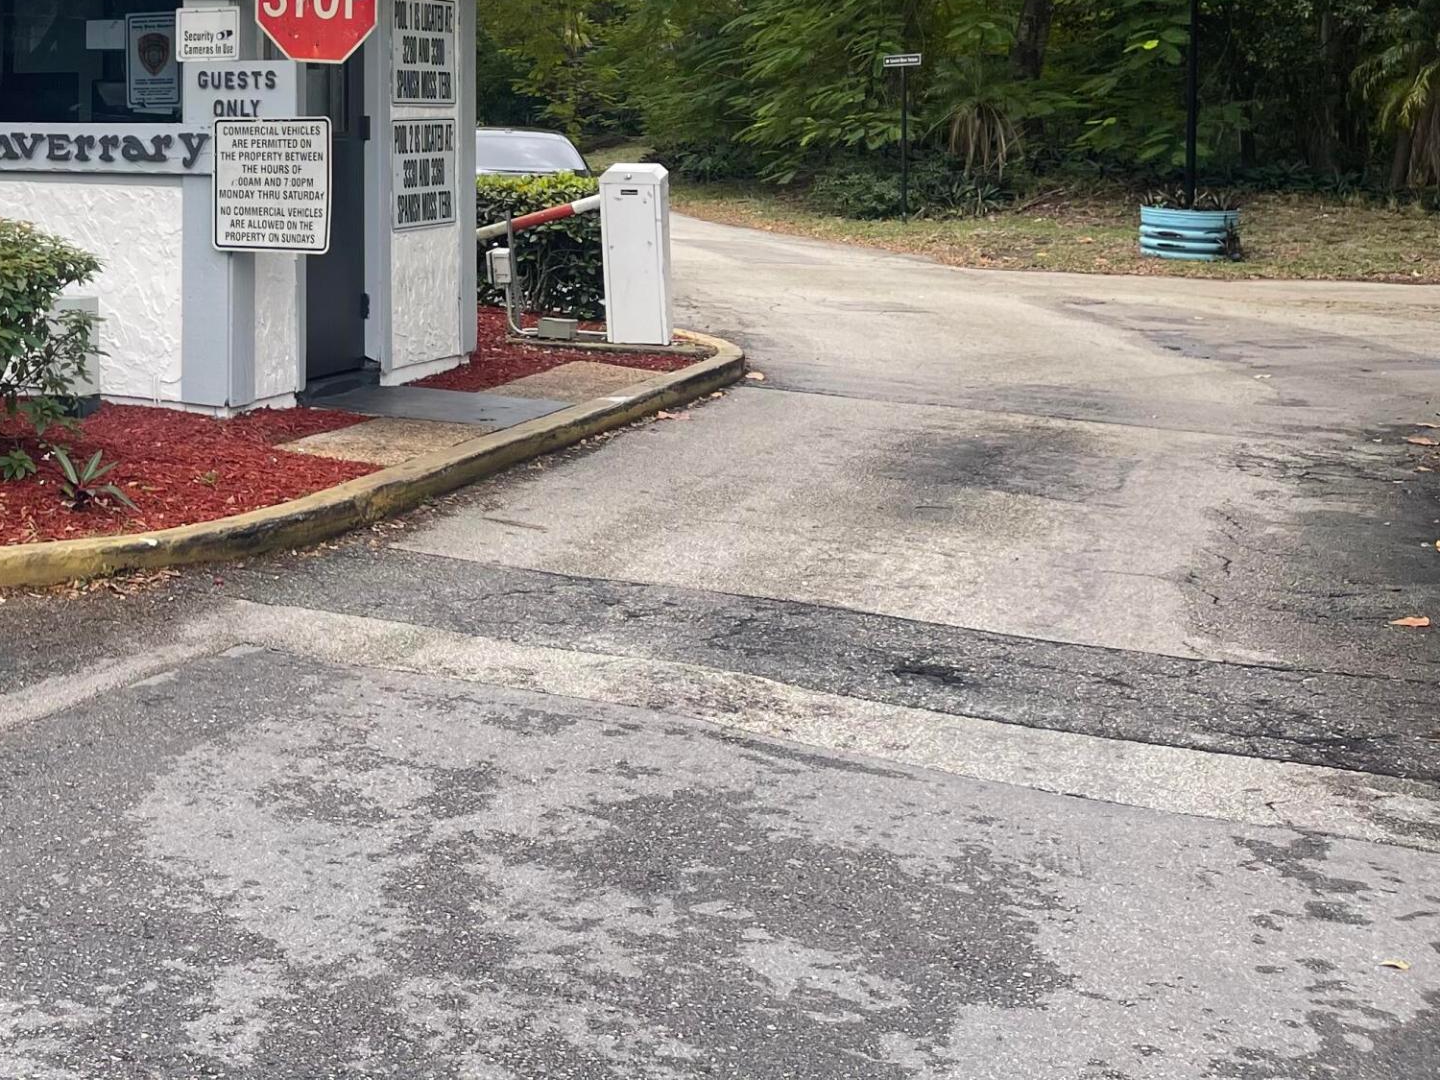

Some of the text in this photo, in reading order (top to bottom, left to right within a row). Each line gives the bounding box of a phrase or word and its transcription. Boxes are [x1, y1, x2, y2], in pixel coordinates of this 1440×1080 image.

[394, 0, 408, 30] POOL
[414, 2, 420, 31] IS
[421, 3, 444, 33] LOCATED
[184, 30, 214, 42] Security
[184, 43, 234, 55] Cameras In Use
[418, 37, 430, 64] AND
[197, 70, 277, 90] GUESTS
[396, 69, 420, 99] SPANISH
[421, 70, 437, 100] MOSS
[213, 99, 262, 117] ONLY
[223, 126, 321, 136] COMMERCIAL VEHICLES
[232, 139, 312, 149] ARE PERMITTED ON
[394, 125, 408, 155] POOL
[409, 124, 414, 153] 2
[414, 124, 420, 153] IS
[421, 124, 444, 153] LOCATED
[220, 151, 324, 161] THE PROPERTY BETWEEN
[242, 164, 303, 174] THE HOURS OF
[419, 158, 430, 187] AND
[264, 178, 282, 187] AND
[284, 178, 314, 187] 7:00PM
[219, 189, 325, 201] MONDAY THRU SATURDAY
[220, 206, 323, 218] NO COMMERCIAL VEHICLES
[397, 193, 420, 224] SPANISH
[422, 191, 437, 221] MOSS
[230, 219, 314, 231] ARE ALLOWED ON THE
[225, 231, 315, 244] PROPERTY ON SUNDAYS
